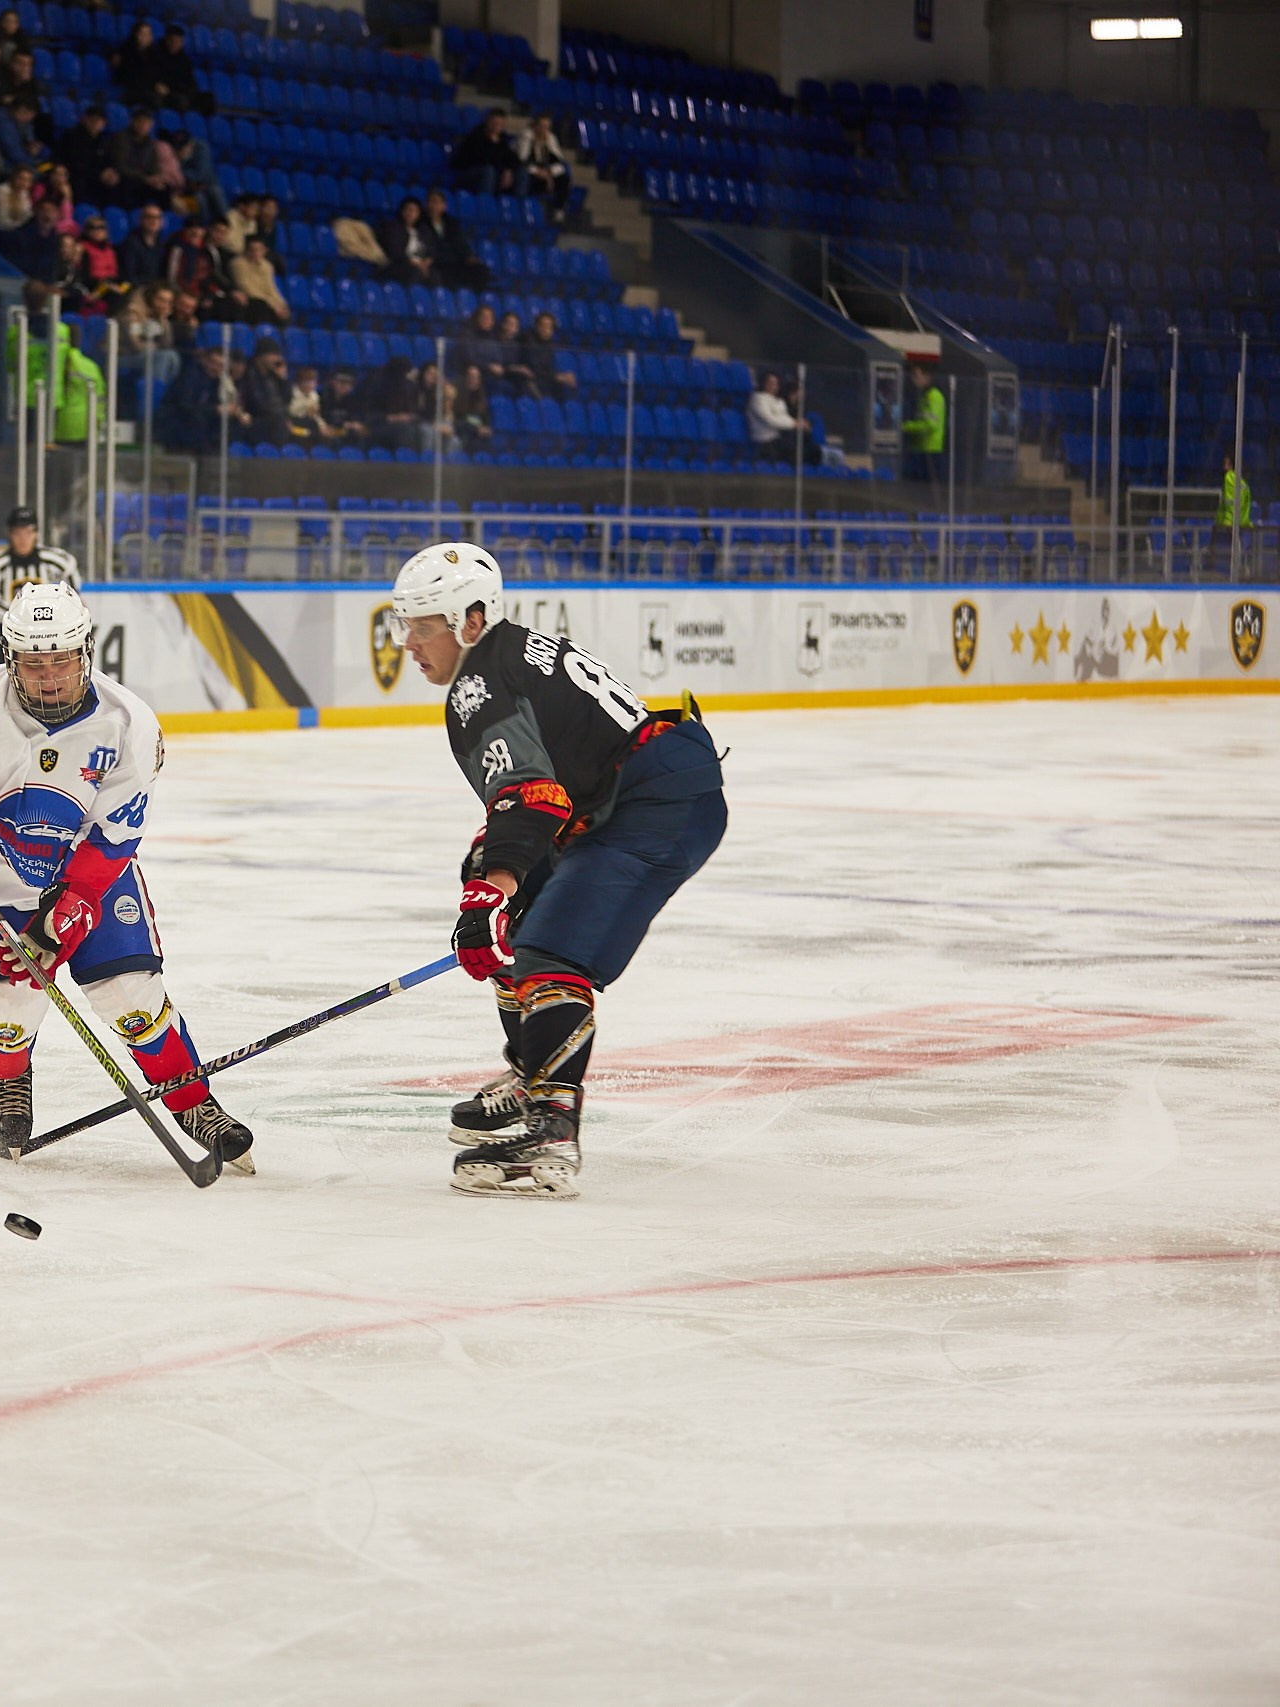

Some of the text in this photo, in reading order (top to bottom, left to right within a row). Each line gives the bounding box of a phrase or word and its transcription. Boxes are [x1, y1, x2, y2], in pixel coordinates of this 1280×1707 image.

[34, 607, 53, 620] 88
[830, 612, 907, 629] ПРАВИТЕЛЬСТВО
[675, 621, 725, 638] НИЖНИЙ
[675, 647, 736, 666] НОВГОРОД
[106, 791, 149, 829] 88
[18, 861, 46, 879] КЛУБ
